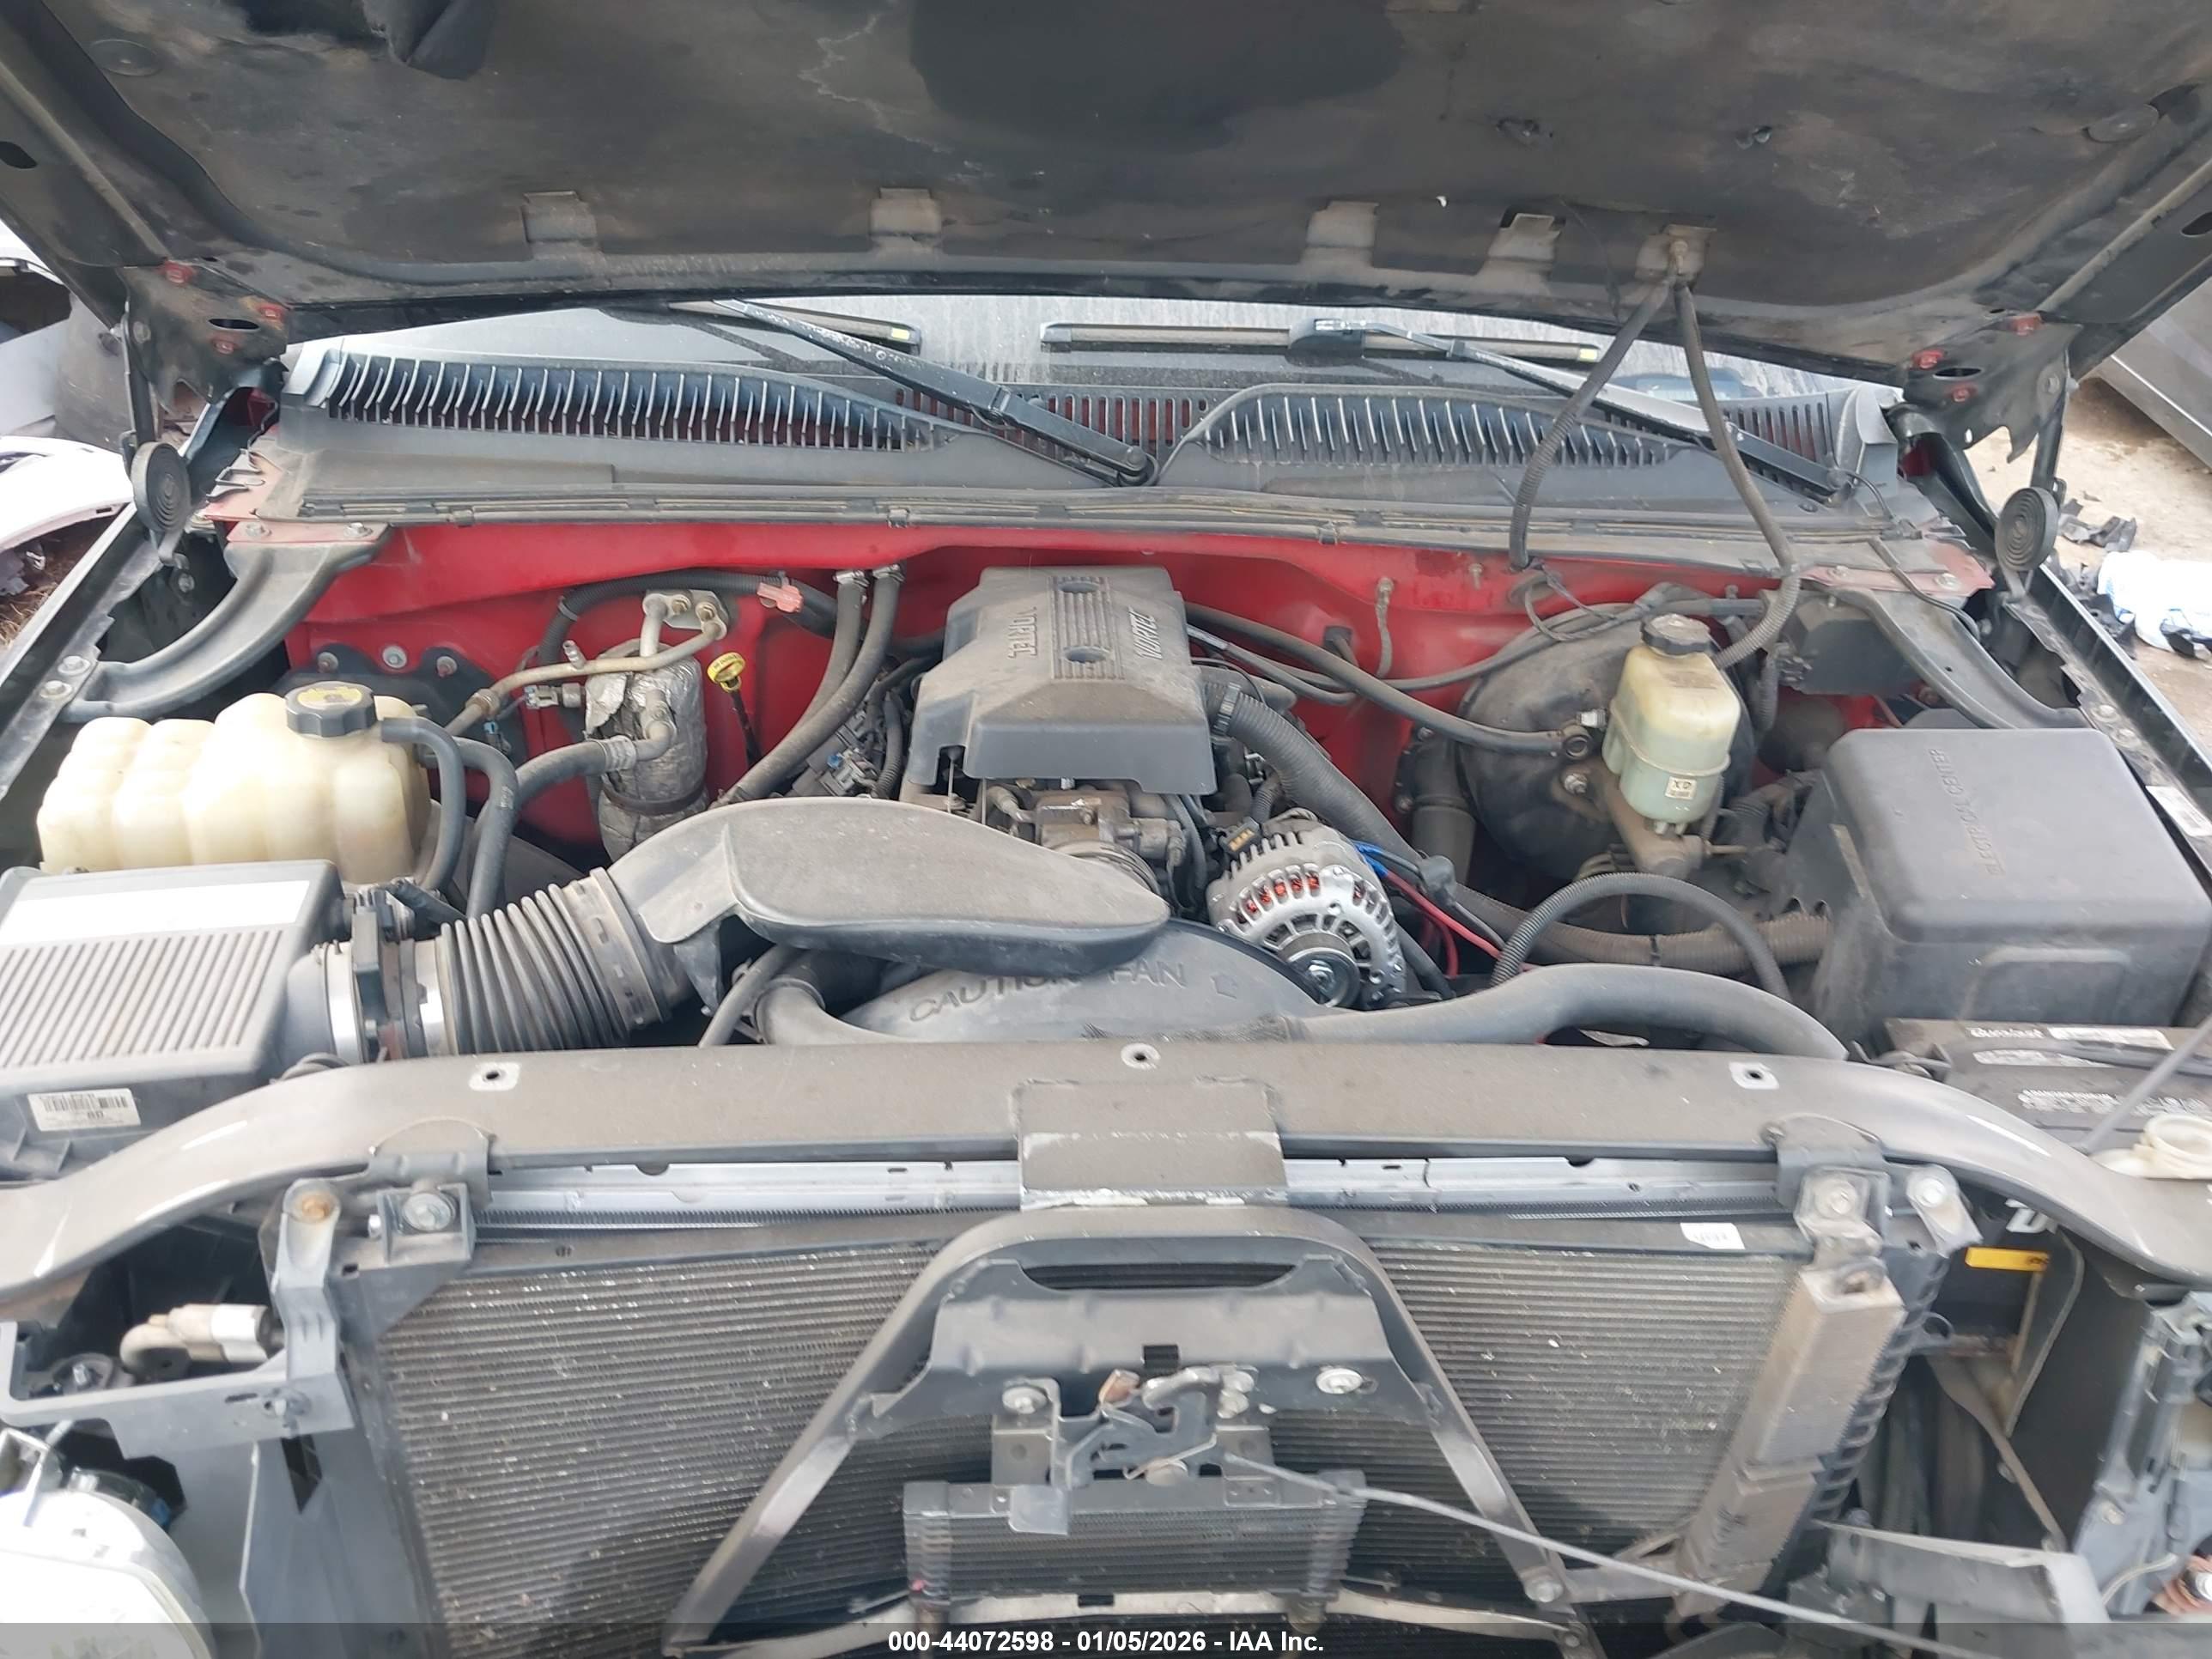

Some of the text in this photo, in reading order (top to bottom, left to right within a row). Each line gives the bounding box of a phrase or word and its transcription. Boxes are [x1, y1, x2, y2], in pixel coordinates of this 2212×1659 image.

[1007, 606, 1037, 659] VORTEC
[1127, 605, 1163, 659] VORTEC
[1929, 748, 2005, 876] ELECTRICAL CENTER
